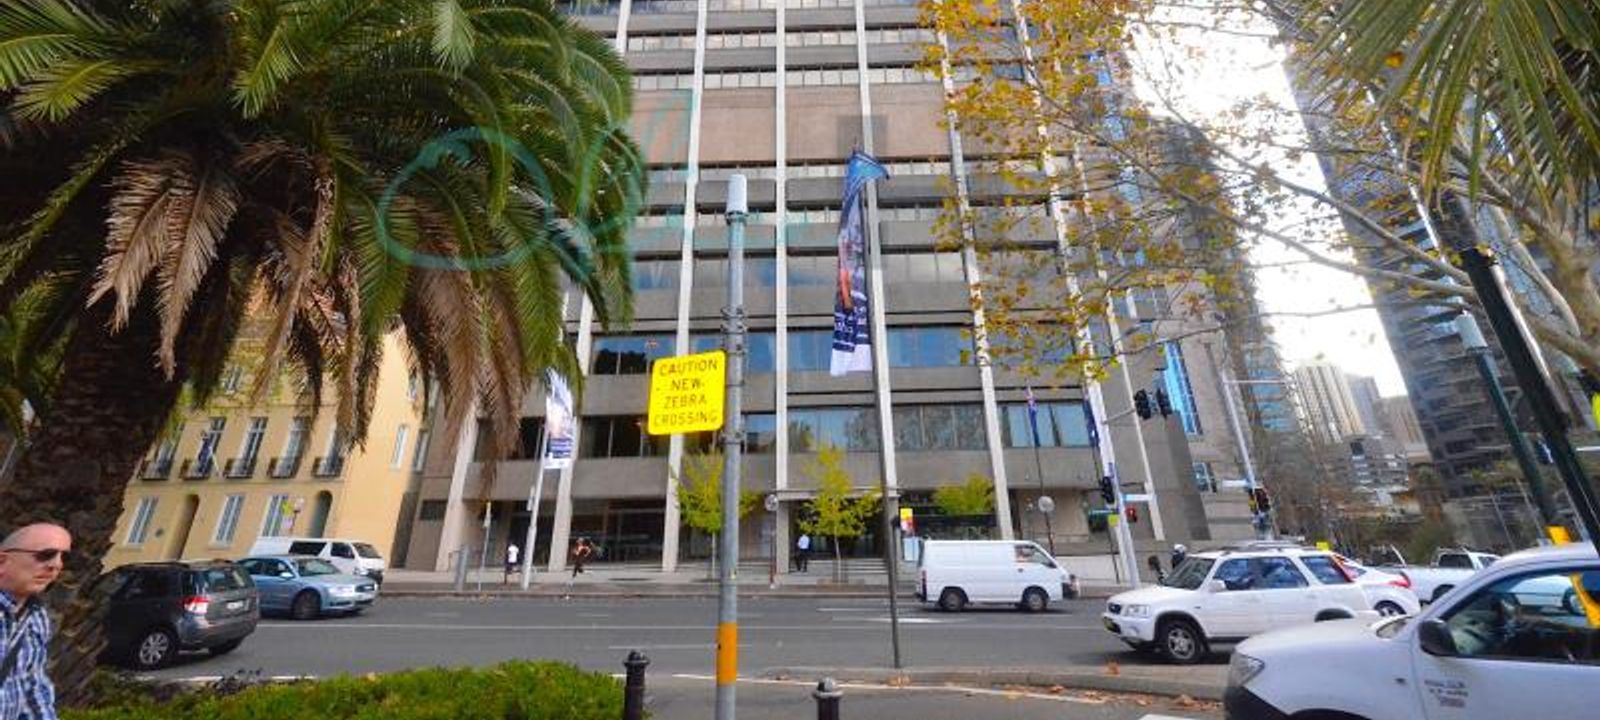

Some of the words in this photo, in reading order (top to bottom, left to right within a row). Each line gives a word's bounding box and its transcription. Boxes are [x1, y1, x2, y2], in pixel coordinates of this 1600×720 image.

[659, 359, 718, 376] CAUTION
[671, 378, 701, 391] NEW
[663, 394, 707, 409] ZEBRA
[654, 410, 718, 426] CROSSING
